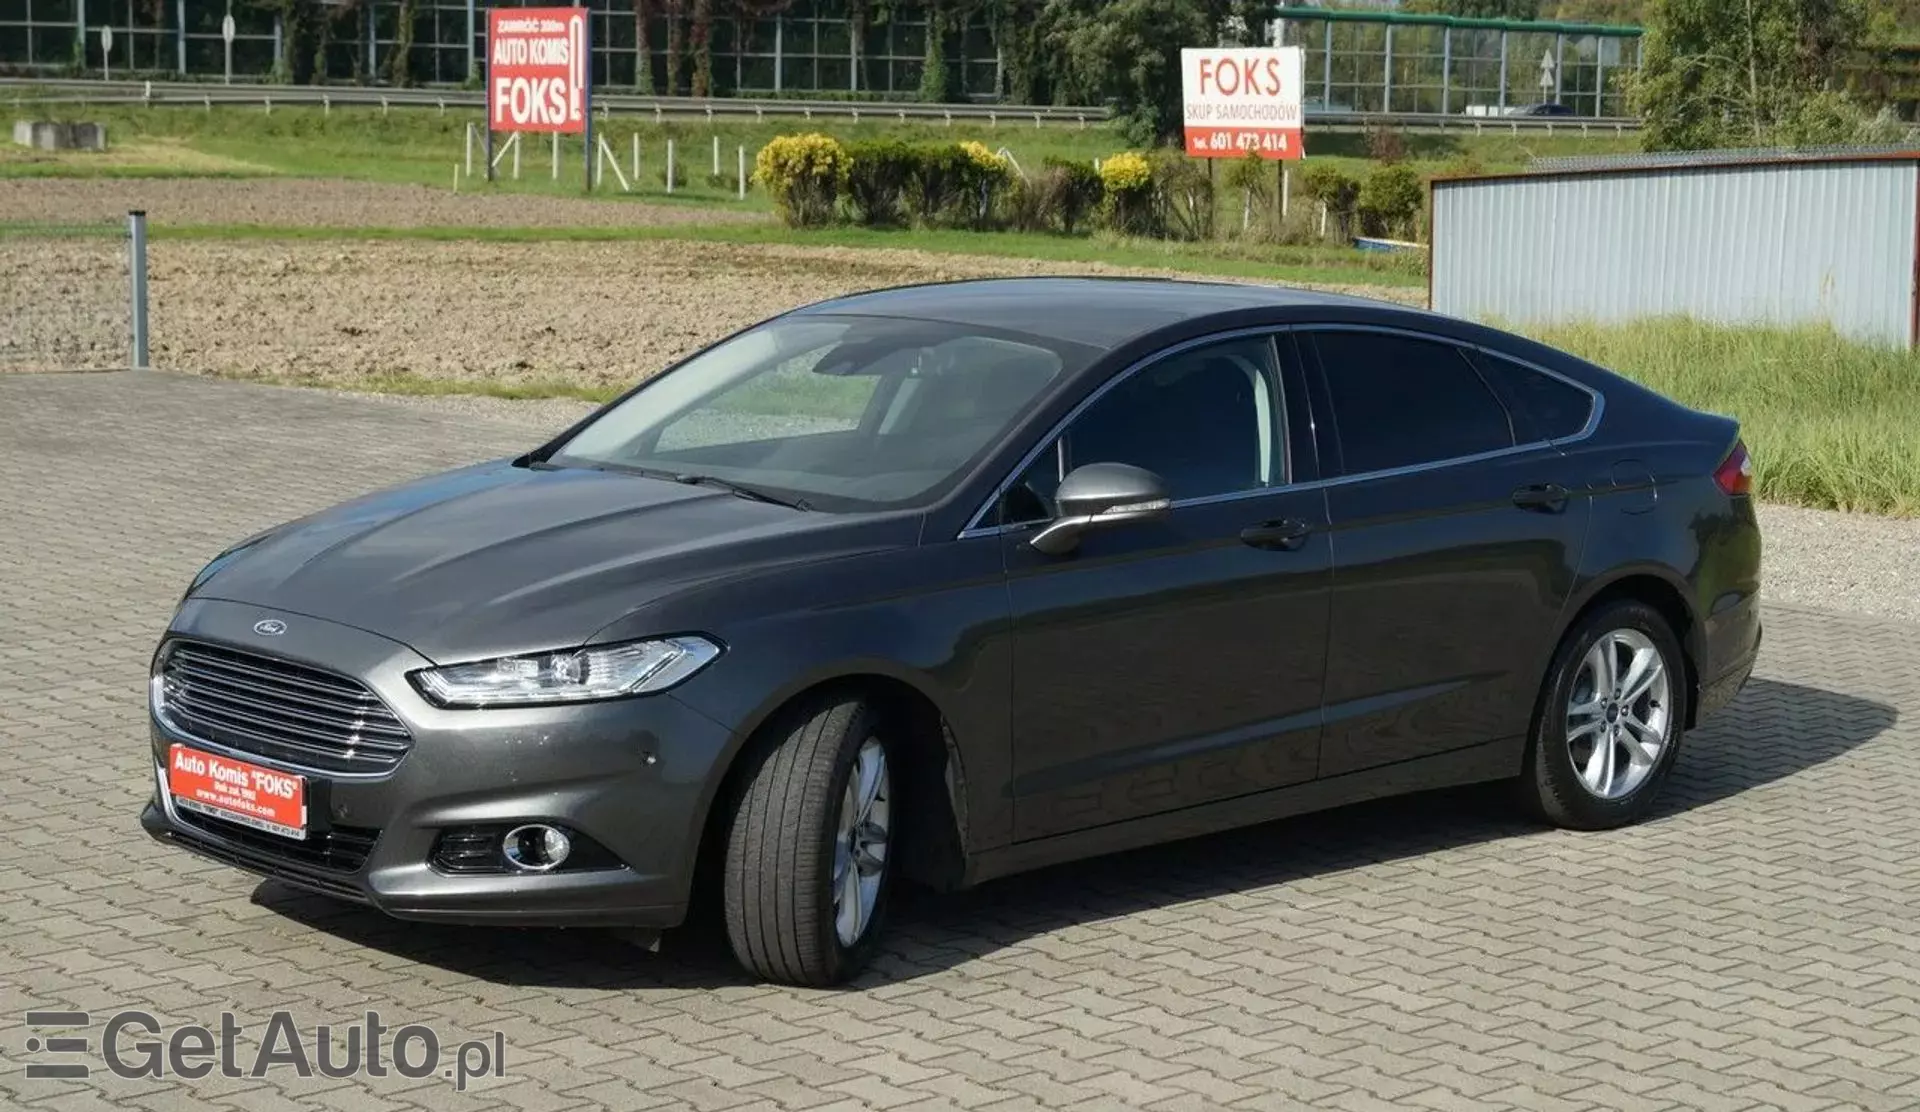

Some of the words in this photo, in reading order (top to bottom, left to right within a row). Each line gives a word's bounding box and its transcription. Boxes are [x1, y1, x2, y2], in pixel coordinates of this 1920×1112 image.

[493, 38, 528, 65] AUTO
[529, 38, 569, 65] KOMIS
[1200, 58, 1281, 96] FOKS
[495, 77, 567, 125] FOKS
[1186, 104, 1213, 120] SKUP
[1216, 101, 1298, 120] SAMOCHODÓW
[1210, 132, 1233, 150] 601
[1236, 132, 1260, 151] 473
[1262, 132, 1288, 152] 414
[175, 752, 205, 775] Auto
[209, 760, 249, 787] Komis
[195, 788, 276, 818] www.autofoks.com
